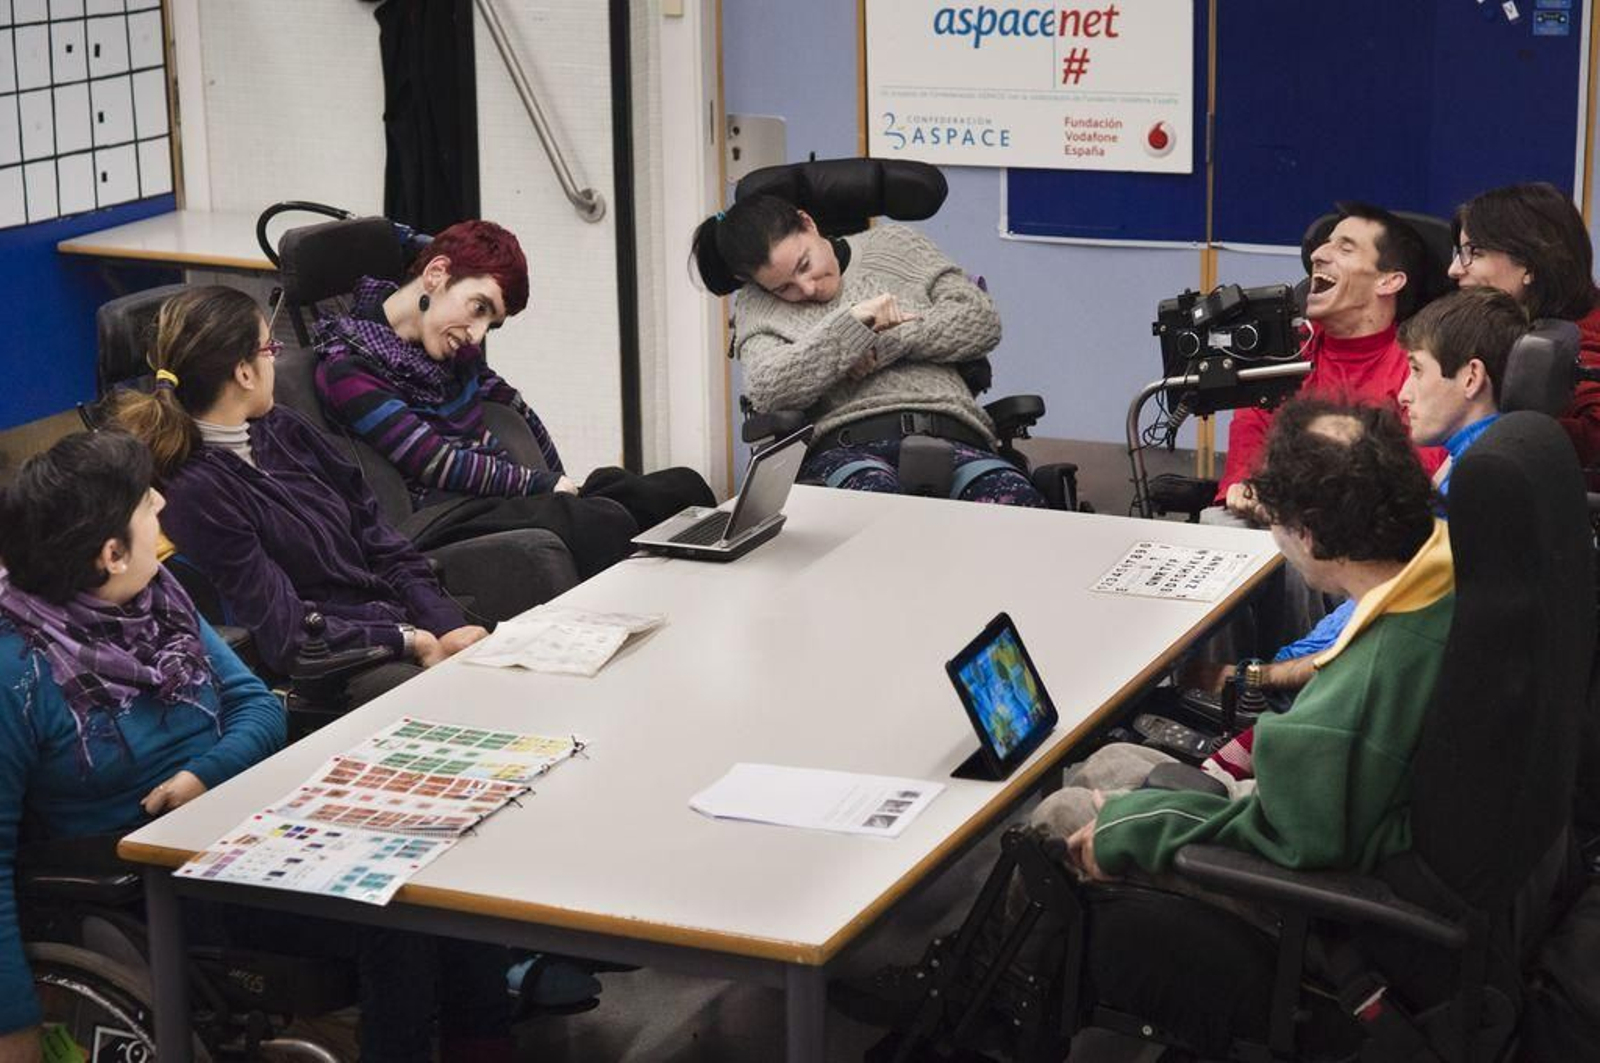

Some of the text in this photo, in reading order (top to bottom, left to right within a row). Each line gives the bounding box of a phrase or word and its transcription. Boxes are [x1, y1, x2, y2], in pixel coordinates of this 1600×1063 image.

[1064, 116, 1123, 129] Fundación
[911, 126, 1010, 147] ASPACE
[1065, 131, 1118, 143] Vodafone
[1064, 145, 1105, 158] España
